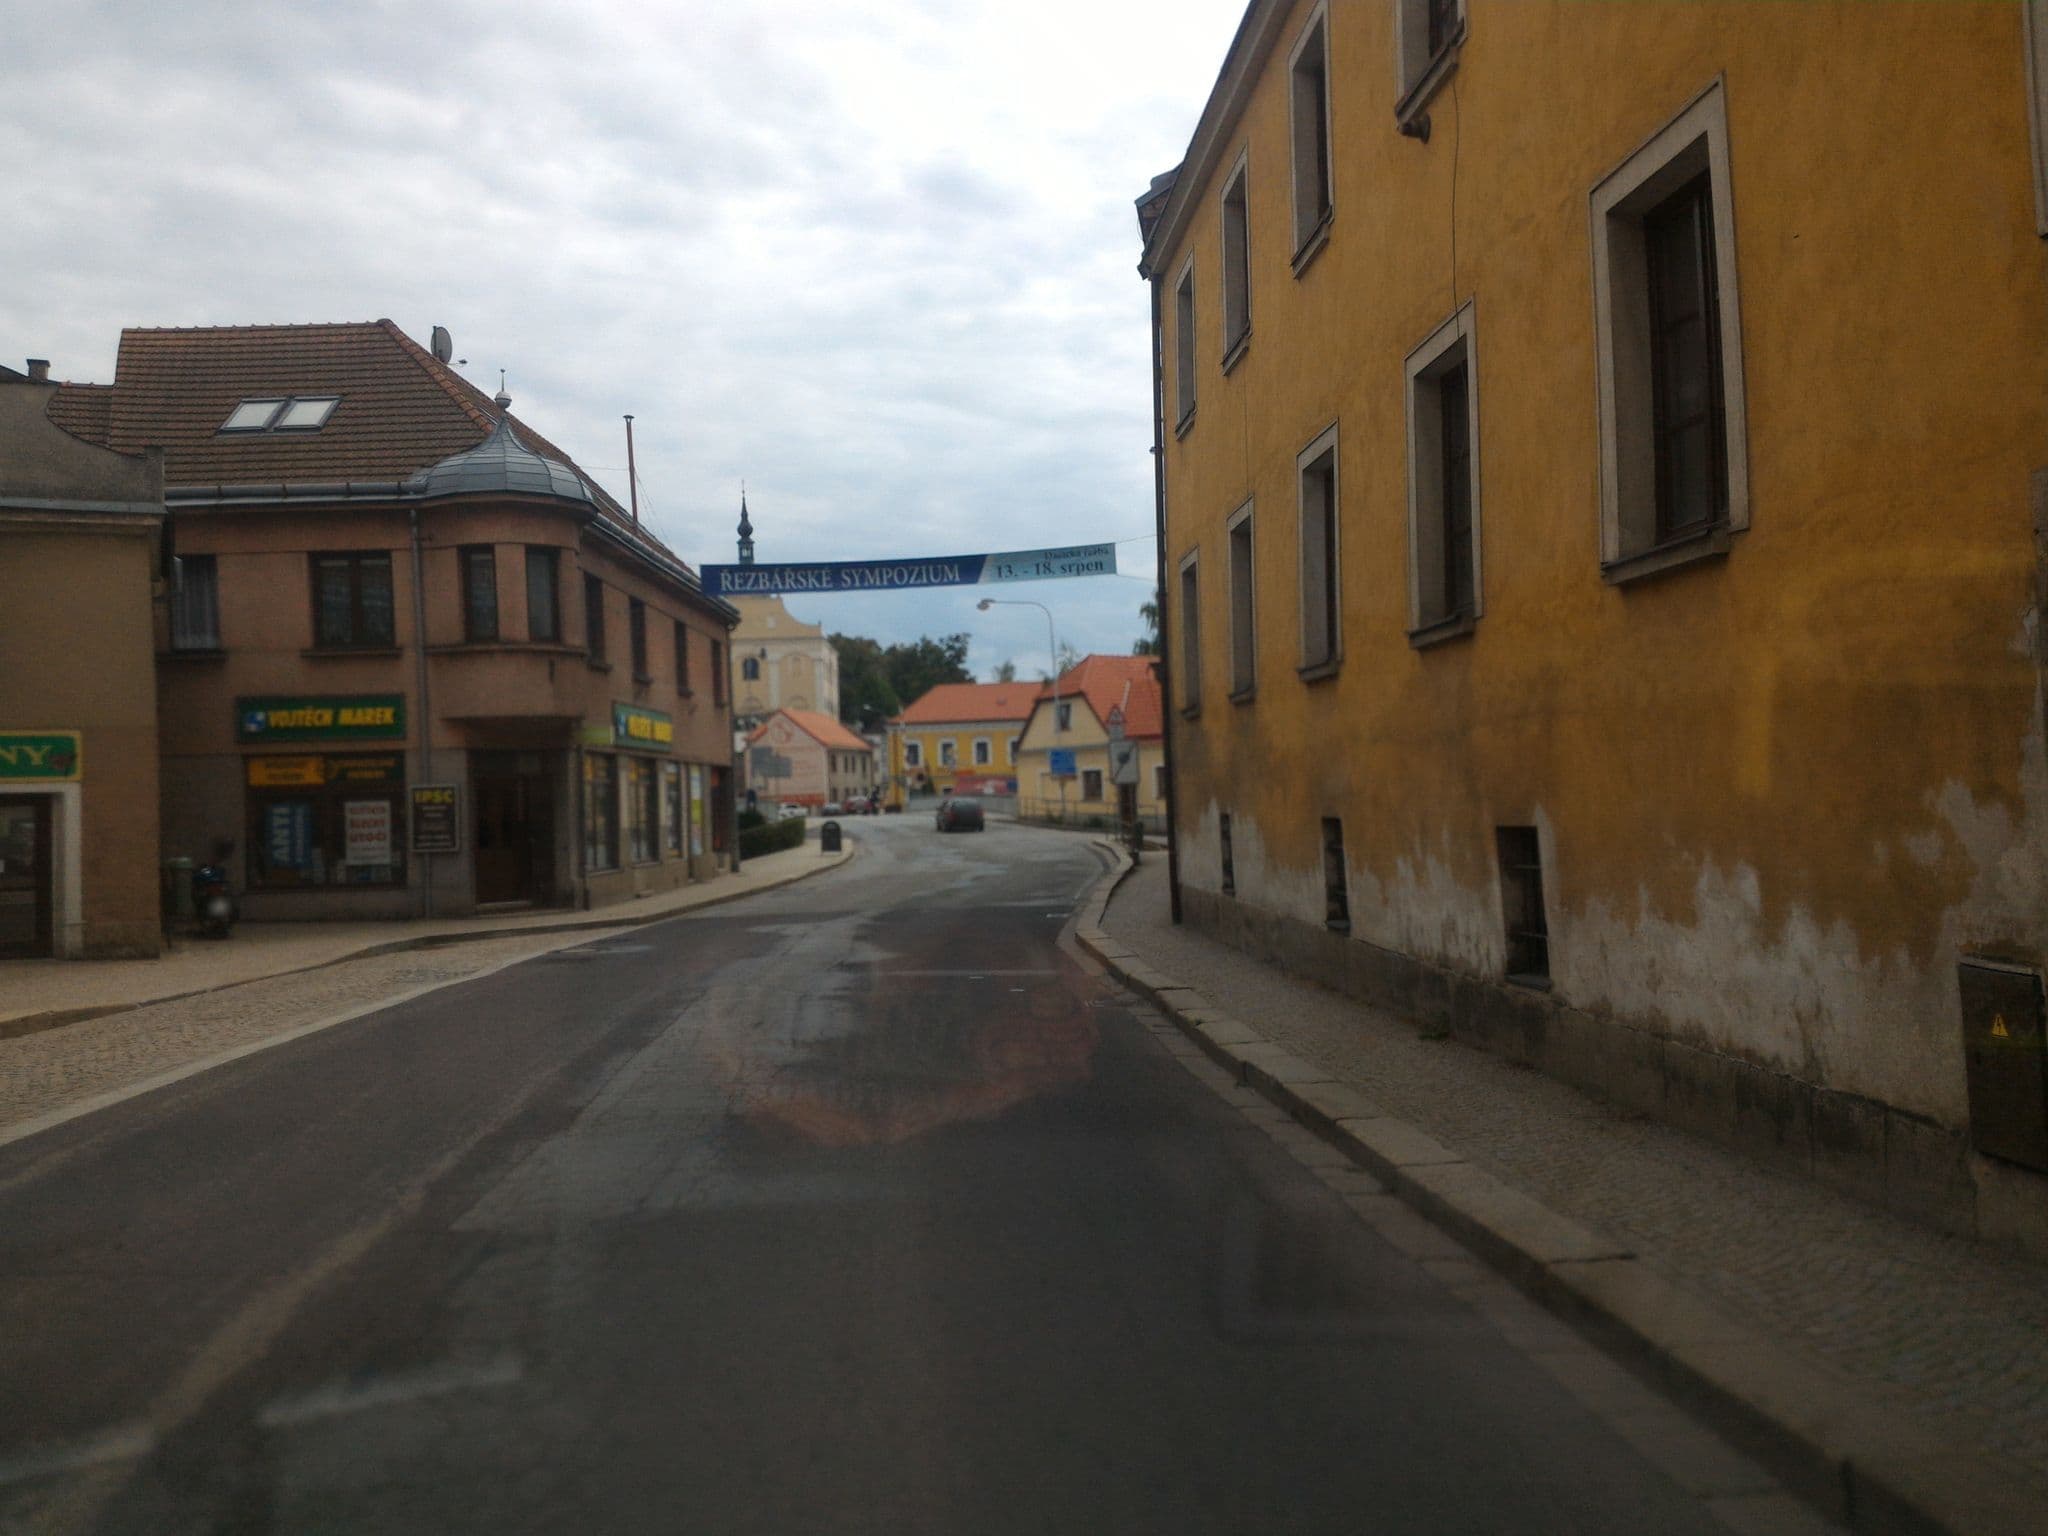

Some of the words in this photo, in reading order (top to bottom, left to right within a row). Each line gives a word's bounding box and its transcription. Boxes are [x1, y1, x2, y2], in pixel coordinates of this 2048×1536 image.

[721, 567, 832, 591] ŘEZBÁŘSKÉ
[841, 564, 961, 587] SYMPOZIUM
[997, 564, 1018, 578] 13.
[1034, 562, 1054, 576] 18.
[1060, 559, 1104, 575] srpen
